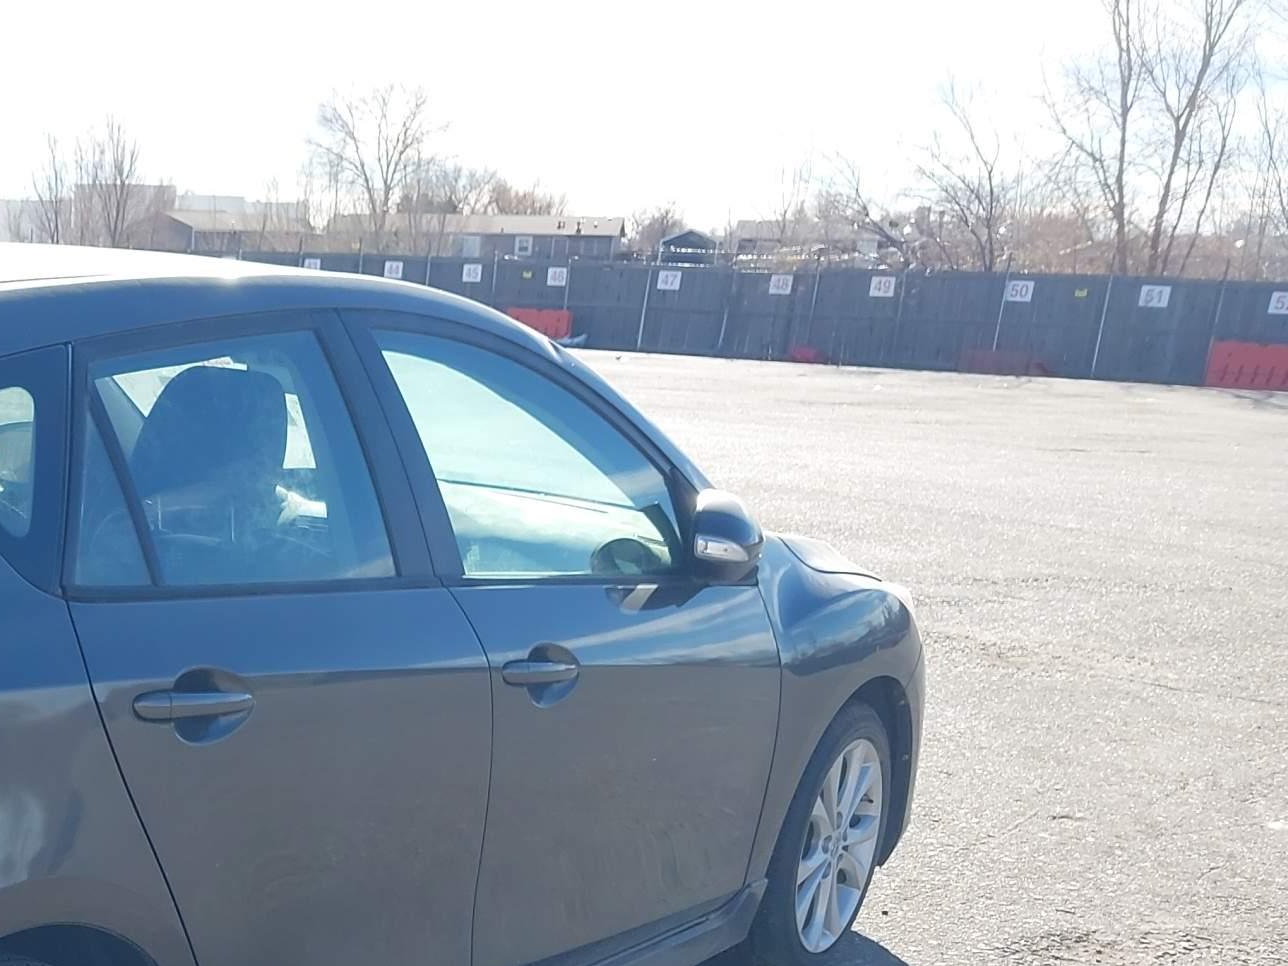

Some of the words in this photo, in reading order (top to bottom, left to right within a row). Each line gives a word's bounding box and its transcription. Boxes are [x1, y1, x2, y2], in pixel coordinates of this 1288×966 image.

[465, 266, 480, 279] 45
[662, 274, 678, 287] 47
[874, 279, 892, 293] 49
[1010, 283, 1029, 298] 50
[1143, 287, 1165, 305] 51
[1274, 295, 1288, 310] 5
